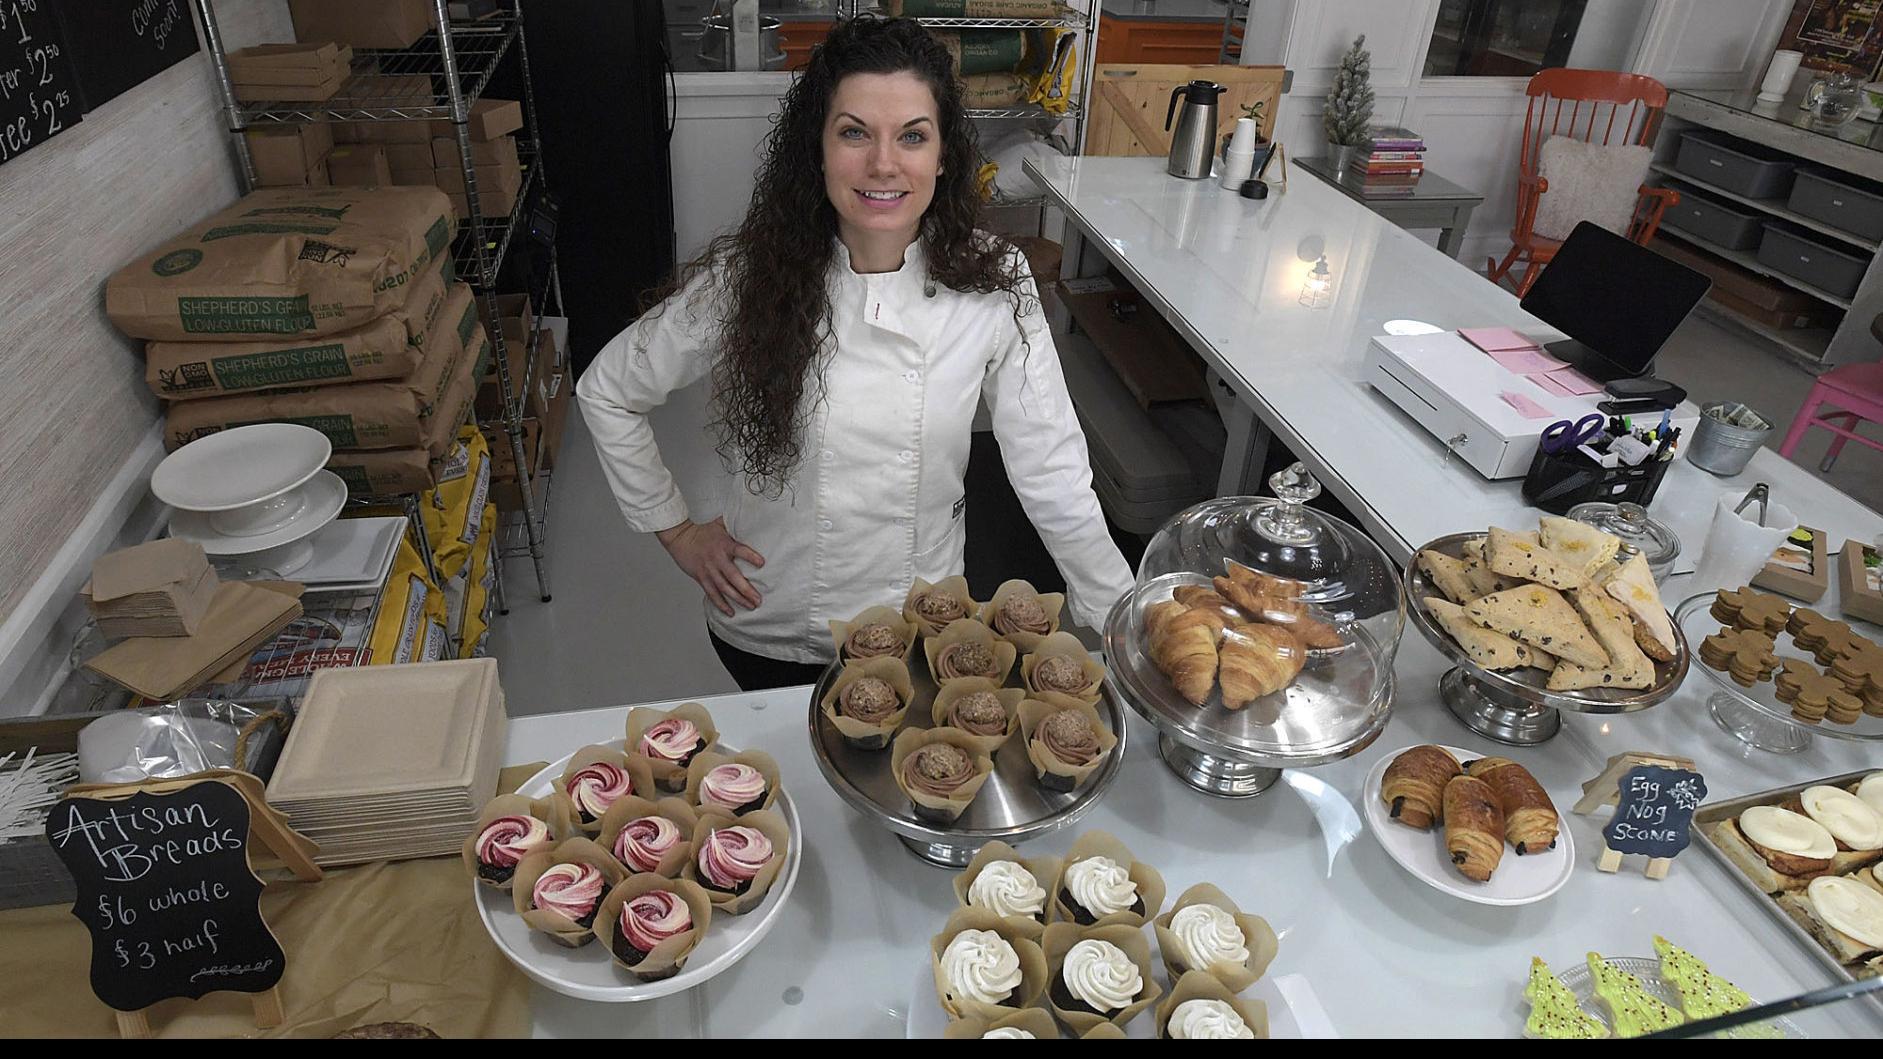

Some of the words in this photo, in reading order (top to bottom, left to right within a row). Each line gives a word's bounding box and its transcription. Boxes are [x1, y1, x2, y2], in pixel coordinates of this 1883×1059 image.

[181, 300, 272, 316] SHEPHERD'S
[215, 352, 300, 374] SHEPHERD'S
[303, 347, 344, 364] GRAIN
[1631, 776, 1661, 802] Egg
[1626, 803, 1668, 825] Nog
[52, 803, 220, 867] Artisan
[1612, 822, 1677, 841] SCONE
[103, 828, 242, 881] Breads
[98, 894, 137, 930] $6
[149, 881, 230, 912] whole
[114, 939, 156, 969] $3
[163, 919, 220, 954] half
